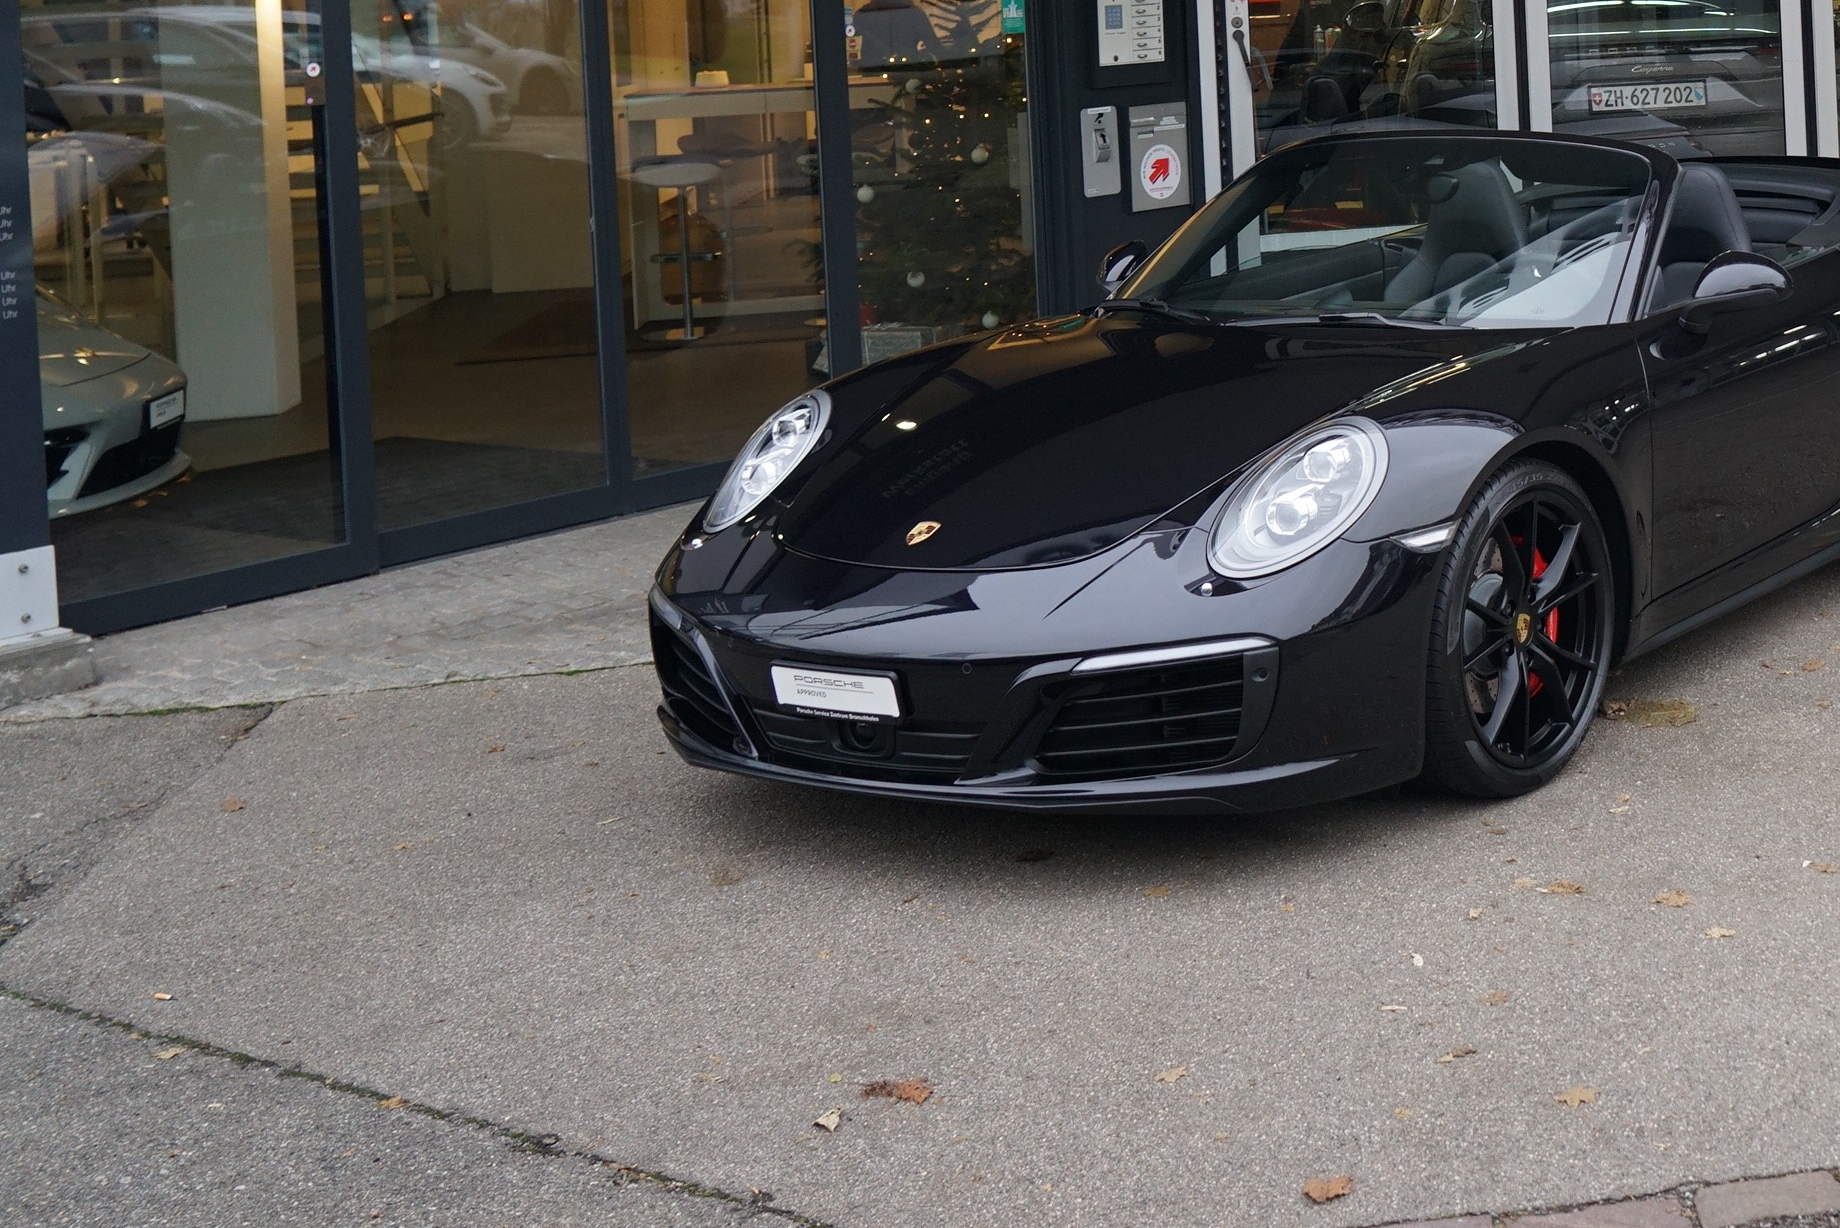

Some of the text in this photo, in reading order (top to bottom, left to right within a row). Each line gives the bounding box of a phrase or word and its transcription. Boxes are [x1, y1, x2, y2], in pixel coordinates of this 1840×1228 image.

[1631, 64, 1674, 75] Cayenne
[0, 270, 16, 281] Uhr
[1, 283, 17, 294] Uhr
[2, 297, 18, 307] Uhr
[2, 310, 18, 320] Uhr
[794, 675, 864, 689] PORSCHE
[796, 688, 827, 699] APPROVED
[796, 707, 814, 715] Porsche
[814, 709, 830, 717] Service
[830, 711, 849, 719] Zentrum
